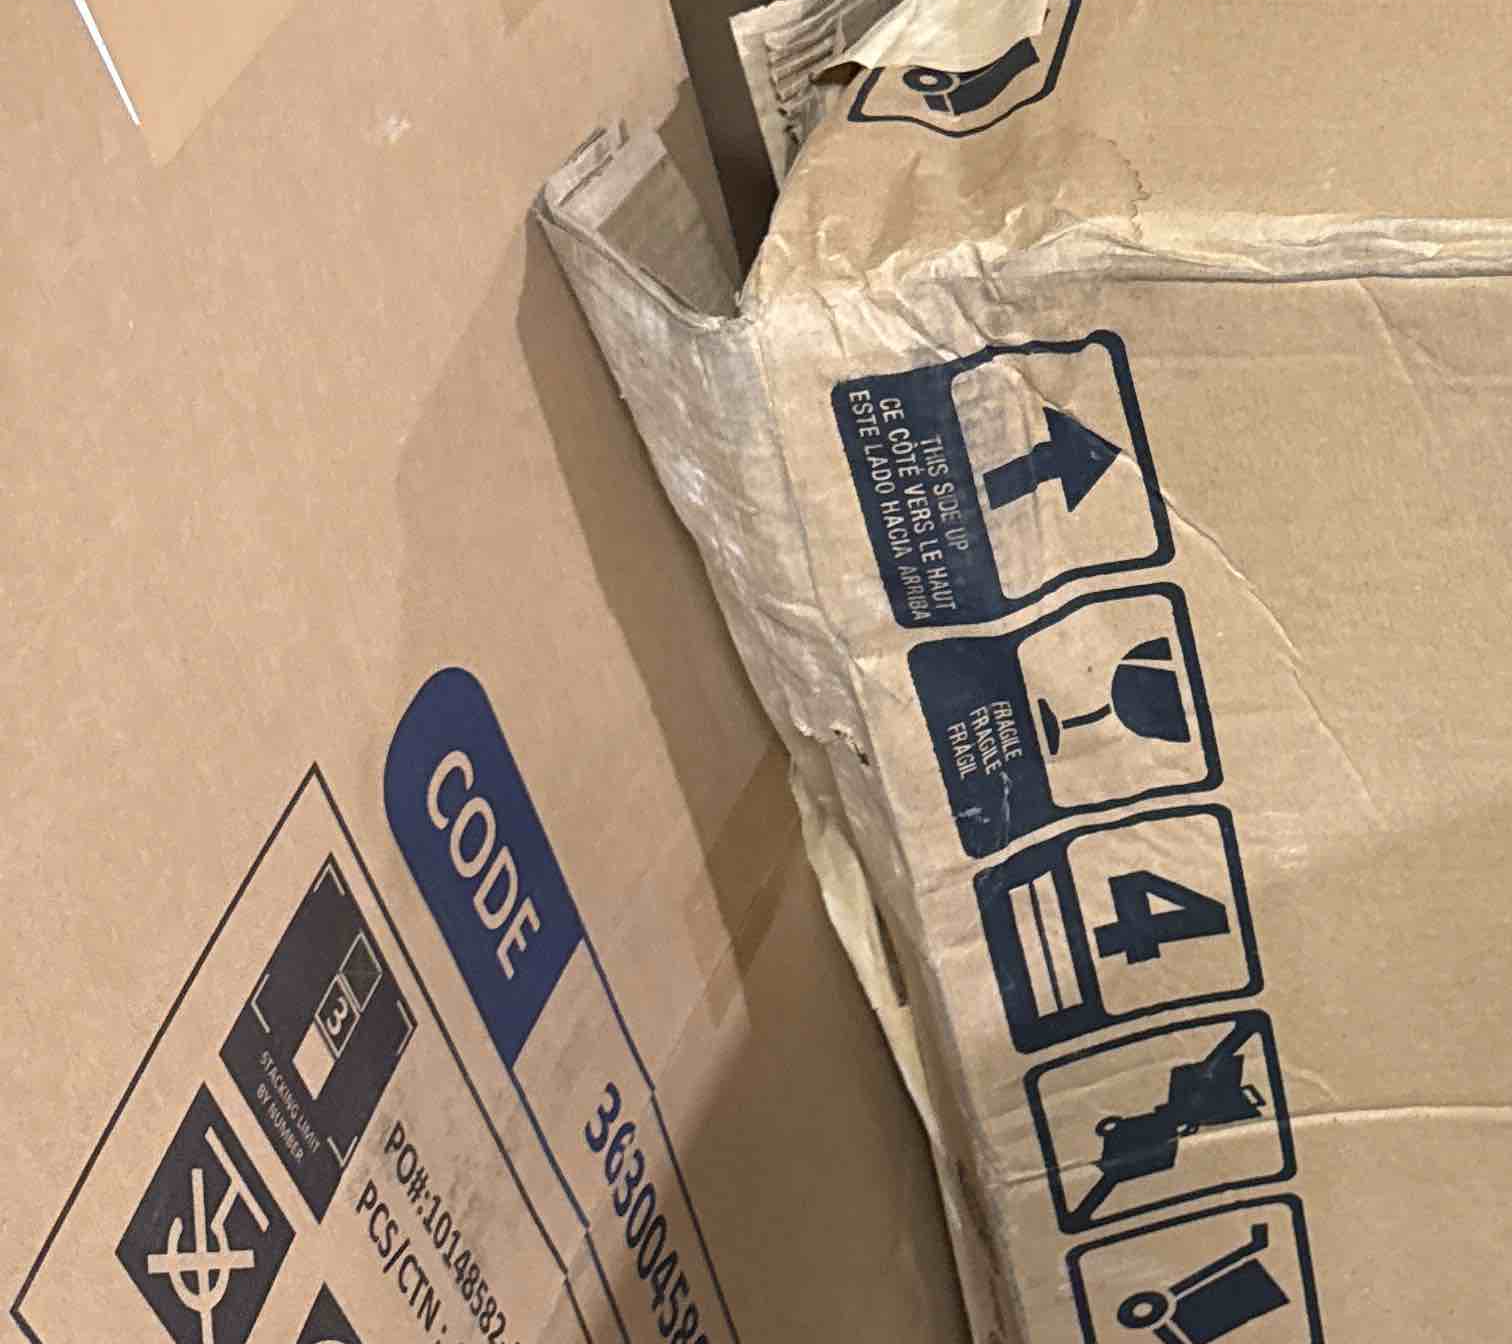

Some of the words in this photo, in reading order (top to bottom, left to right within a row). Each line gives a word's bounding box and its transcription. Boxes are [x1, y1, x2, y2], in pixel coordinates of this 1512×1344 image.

[849, 389, 881, 438] ESTE
[880, 397, 904, 423] CE
[864, 443, 895, 494] LADO
[921, 432, 949, 478] THIS
[904, 482, 936, 534] VERS
[932, 481, 961, 523] SIDE
[880, 500, 913, 559] HACIA
[919, 539, 944, 564] LE
[945, 527, 969, 551] UP
[899, 565, 932, 621] ARRIBA
[927, 567, 957, 611] HAUT
[947, 721, 977, 780] FRAGIL
[969, 706, 1002, 775] FRAGILE
[992, 700, 1022, 763] FRAGILE
[426, 750, 541, 980] CODE
[1094, 870, 1231, 965] 4
[327, 996, 349, 1036] 3
